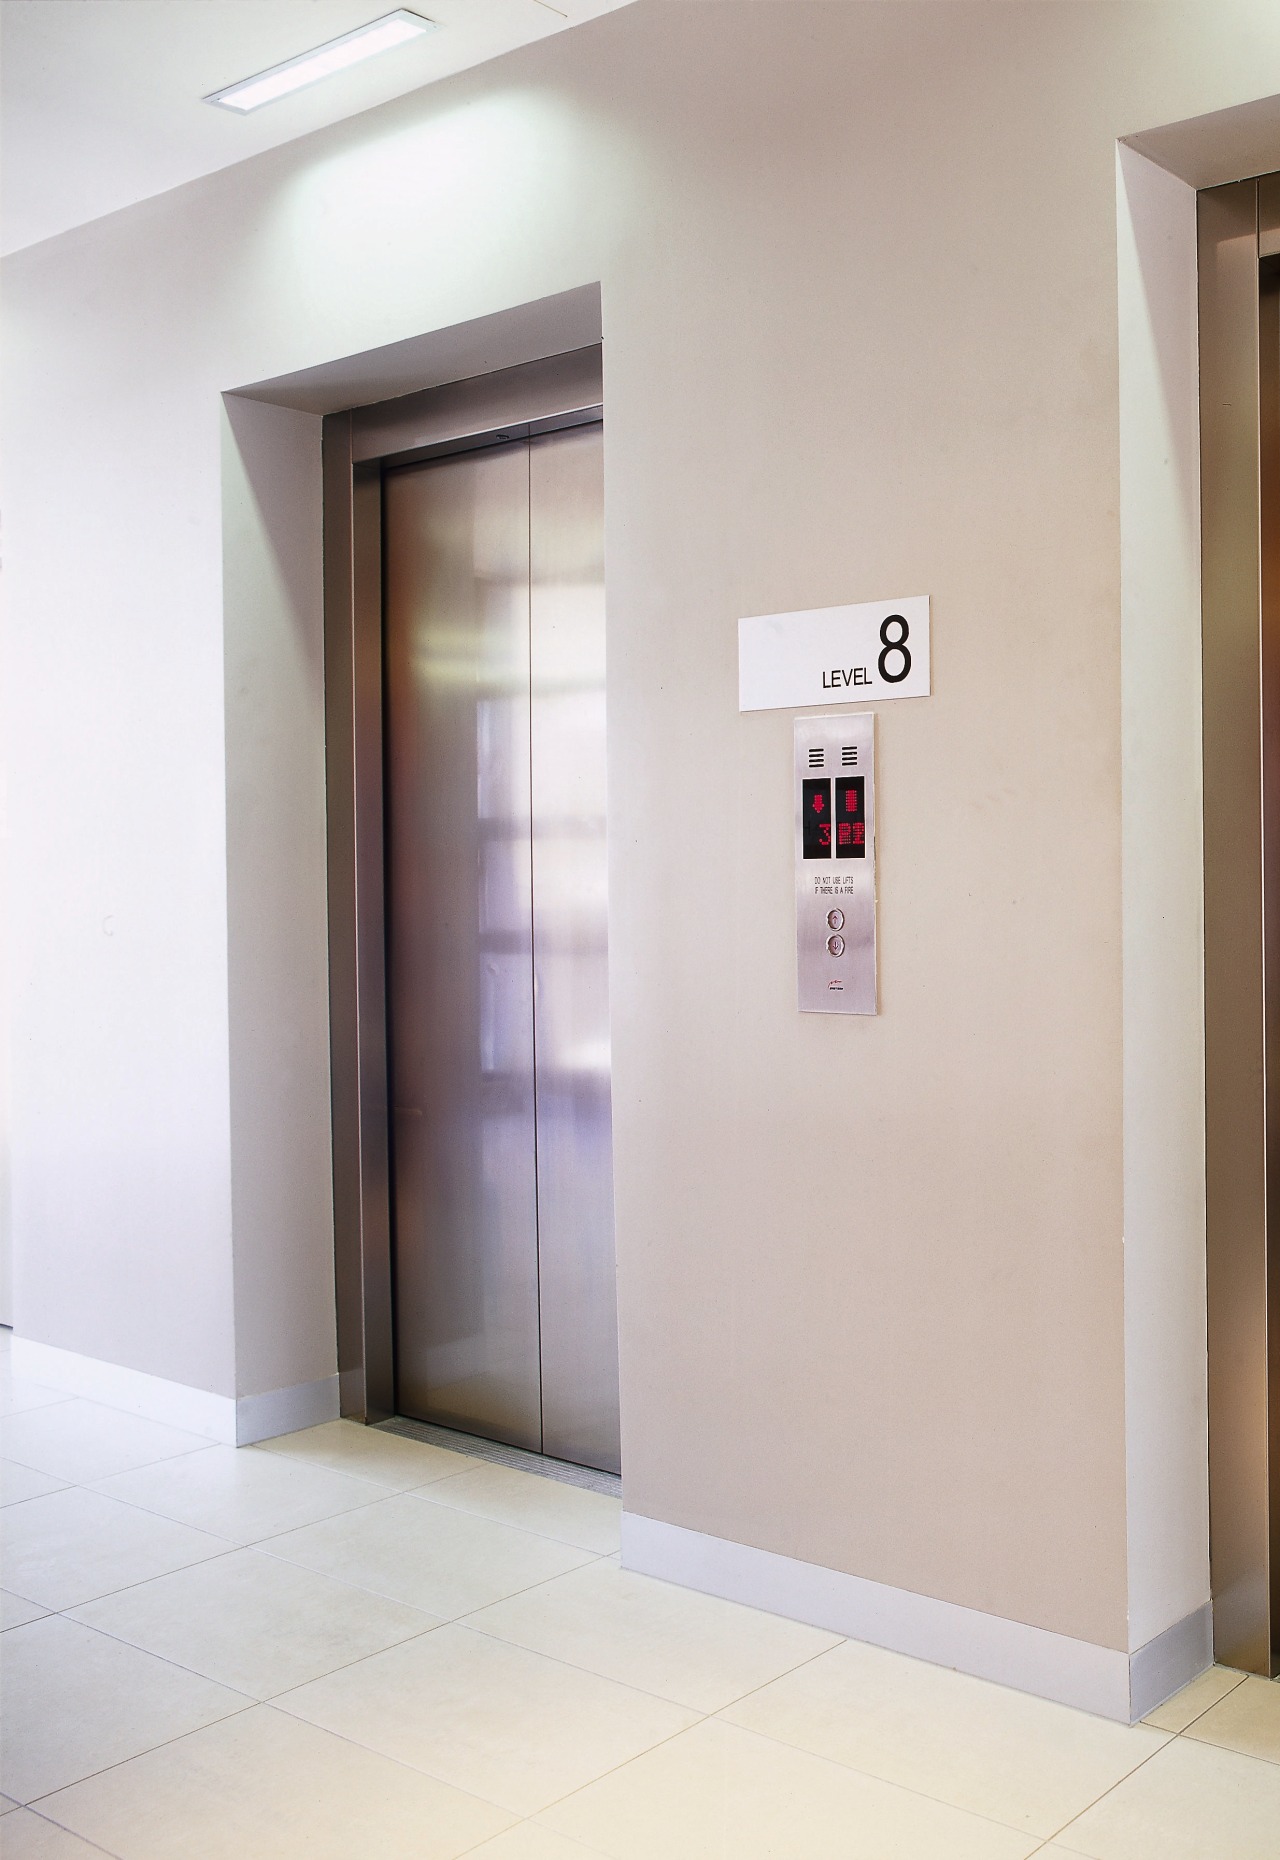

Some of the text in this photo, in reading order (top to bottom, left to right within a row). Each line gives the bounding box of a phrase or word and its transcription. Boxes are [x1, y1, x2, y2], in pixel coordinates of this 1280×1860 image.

[822, 614, 912, 689] LEVEL 8
[819, 823, 831, 846] 3
[814, 876, 854, 885] DO NOT USE LIFTS
[820, 886, 833, 895] THERE
[844, 886, 854, 895] FIRE
